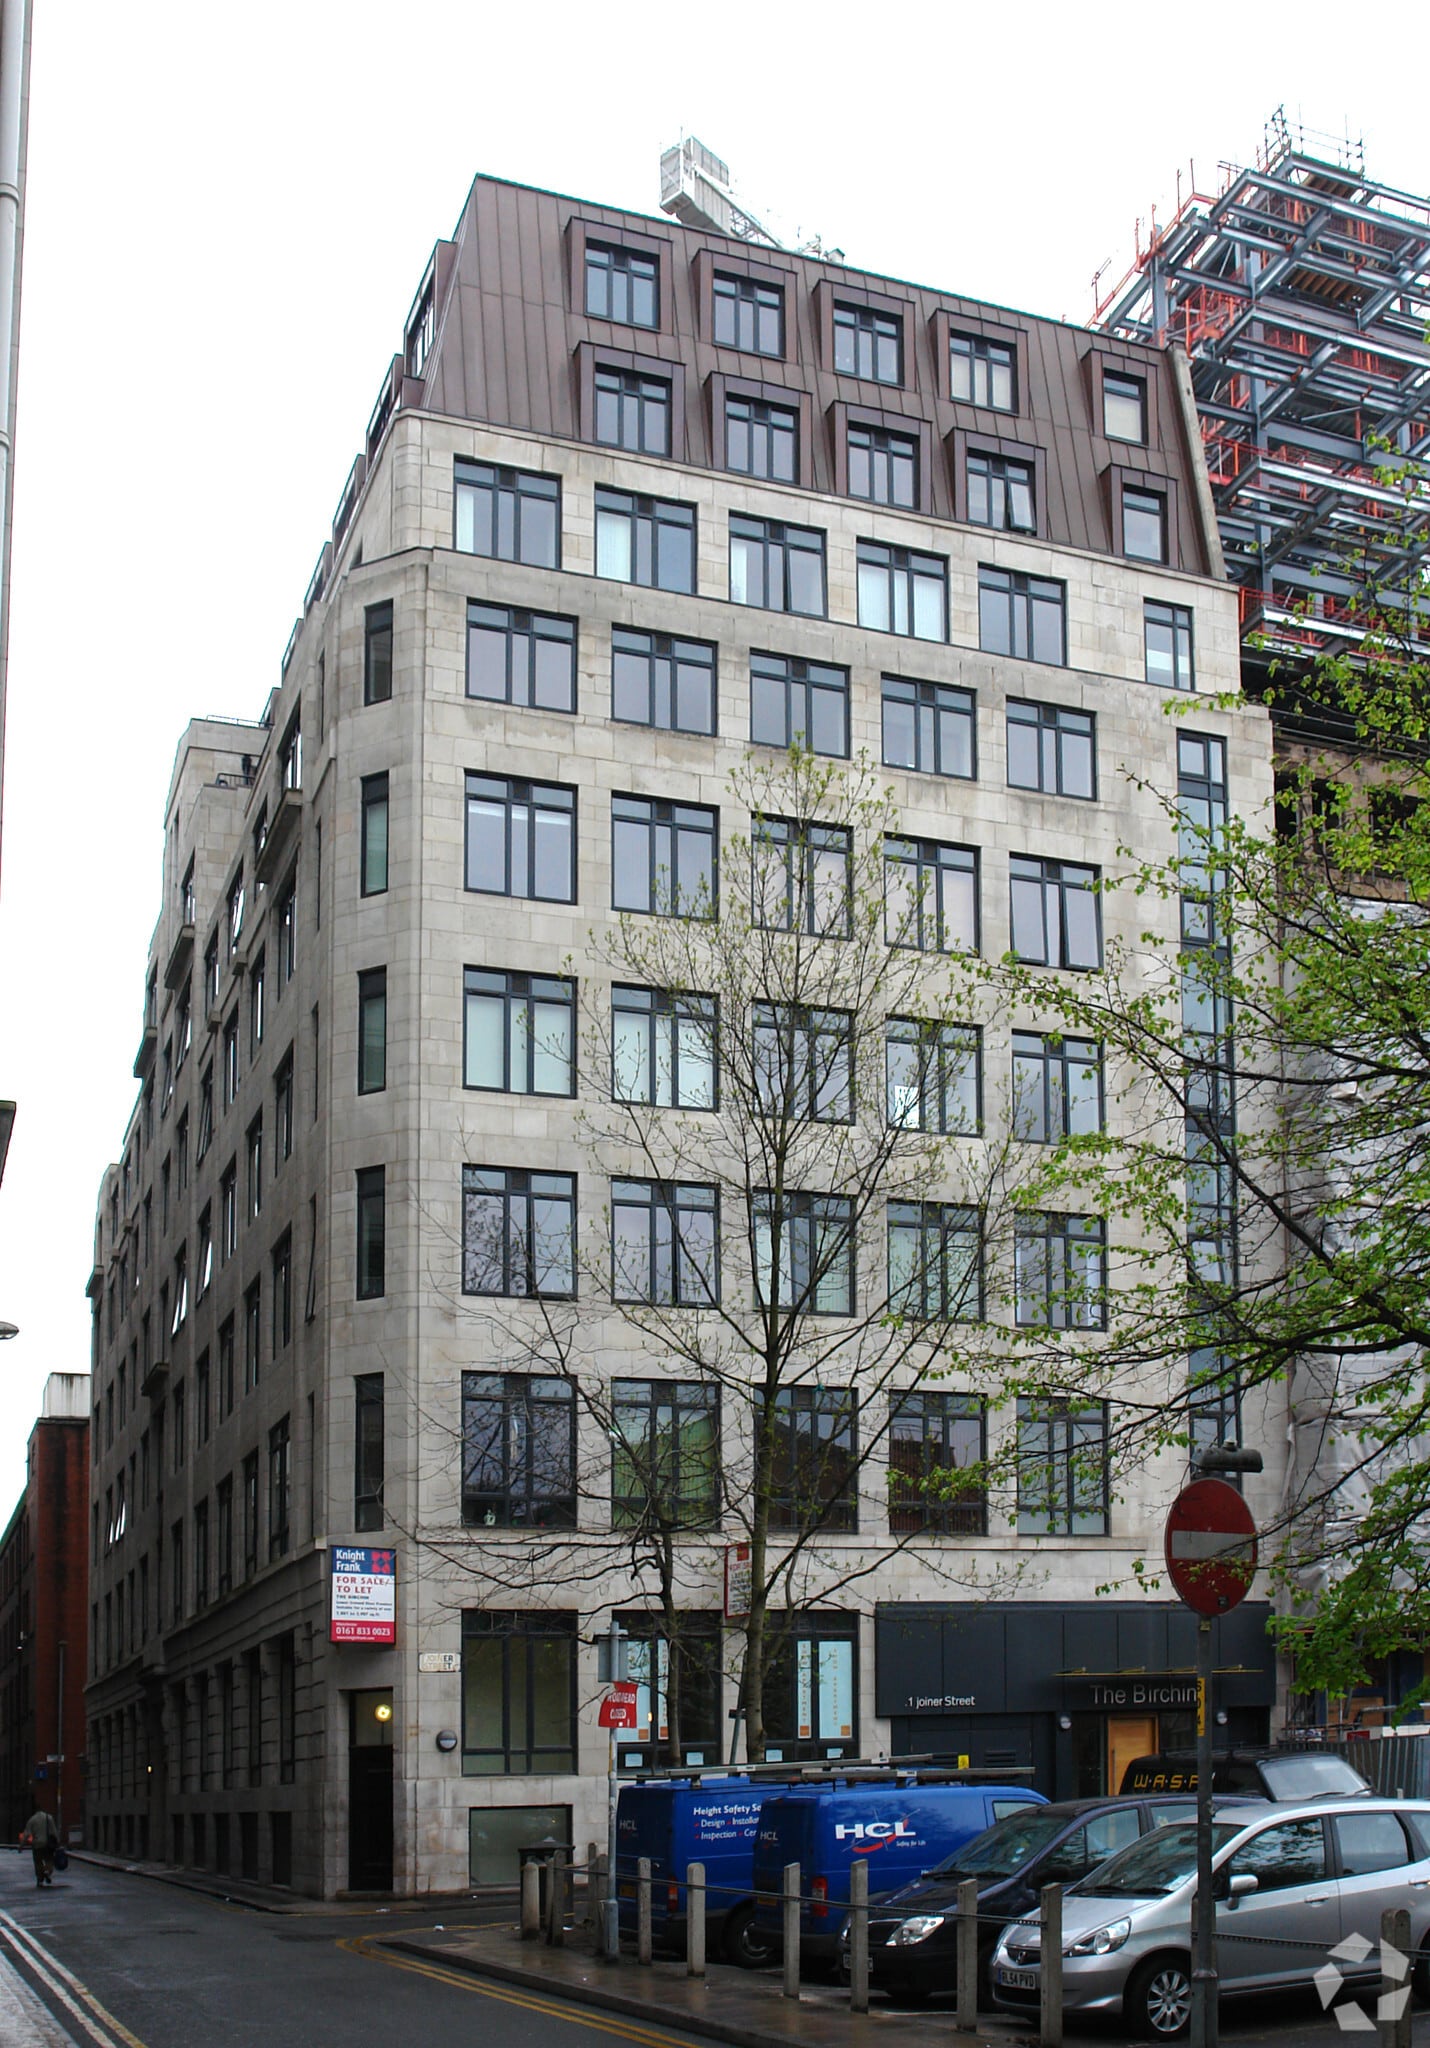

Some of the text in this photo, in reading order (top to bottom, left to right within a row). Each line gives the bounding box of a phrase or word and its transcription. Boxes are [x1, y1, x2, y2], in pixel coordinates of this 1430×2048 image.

[336, 1549, 365, 1563] Knight
[336, 1561, 361, 1572] Frank
[336, 1576, 357, 1584] FOR
[336, 1585, 373, 1594] TO LET
[336, 1626, 355, 1635] 0161
[356, 1627, 371, 1636] 833
[1090, 1684, 1197, 1704] The Birchin
[916, 1696, 943, 1709] joiner
[944, 1695, 976, 1706] Street
[693, 1806, 721, 1817] Height
[723, 1804, 751, 1815] Safety
[619, 1819, 638, 1831] HCL
[701, 1819, 726, 1829] Design
[701, 1831, 737, 1841] Inspection
[760, 1832, 779, 1841] HCL
[835, 1822, 917, 1840] HCL
